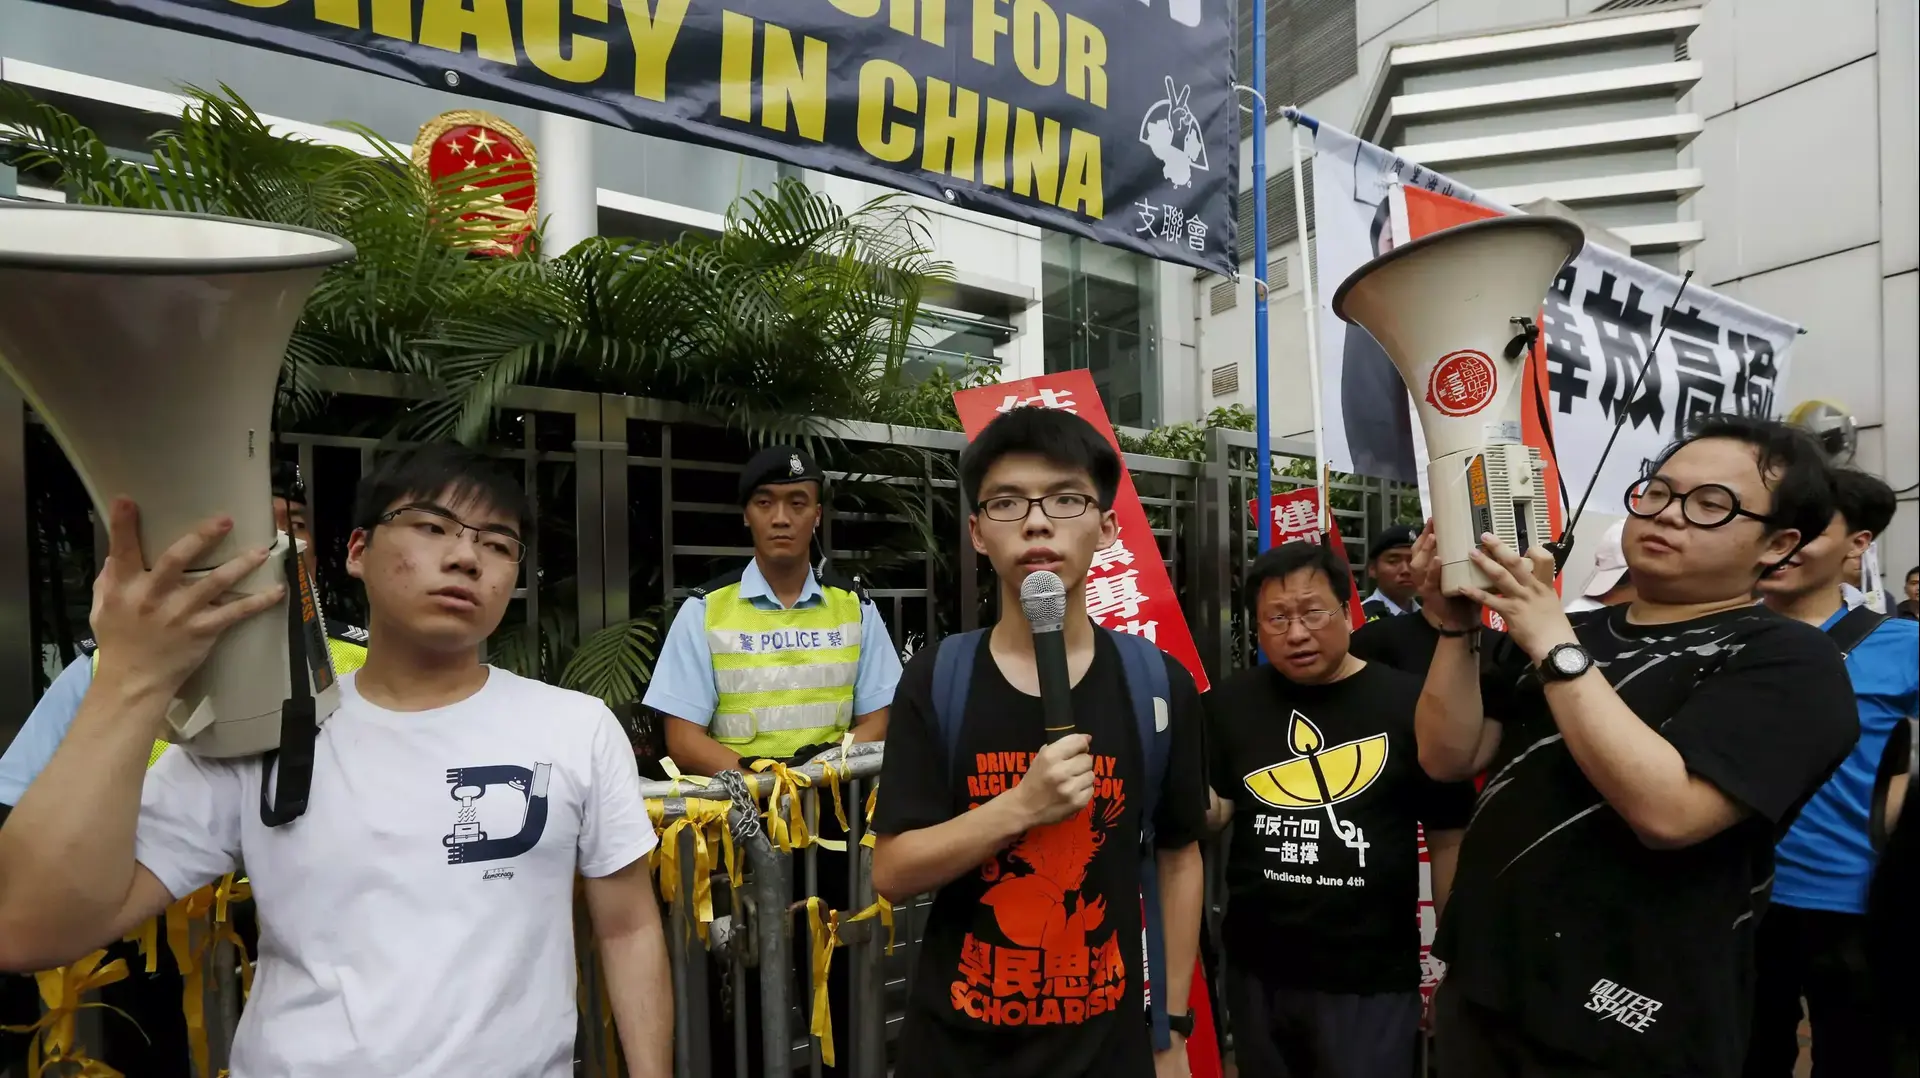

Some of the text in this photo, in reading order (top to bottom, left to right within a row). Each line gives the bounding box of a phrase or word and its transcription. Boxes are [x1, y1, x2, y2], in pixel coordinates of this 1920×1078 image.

[971, 0, 1108, 110] FOR
[228, 0, 1105, 220] ACY IN CHINA
[1133, 196, 1210, 252] 支聯會
[1468, 455, 1488, 505] WIRELESS
[297, 554, 316, 622] RELESS
[761, 631, 821, 651] POLICE
[826, 631, 842, 647] 察
[975, 752, 1027, 774] DRIVE
[966, 774, 1023, 798] RECLA
[1253, 814, 1320, 840] 平反六四
[482, 870, 515, 881] democracy
[1263, 868, 1366, 887] Vindicate June 4th
[957, 929, 1127, 999] 學民思潮
[950, 975, 1127, 1026] SCHOLARISM
[1583, 993, 1657, 1034] SPACE
[1588, 977, 1664, 1017] OUTER
